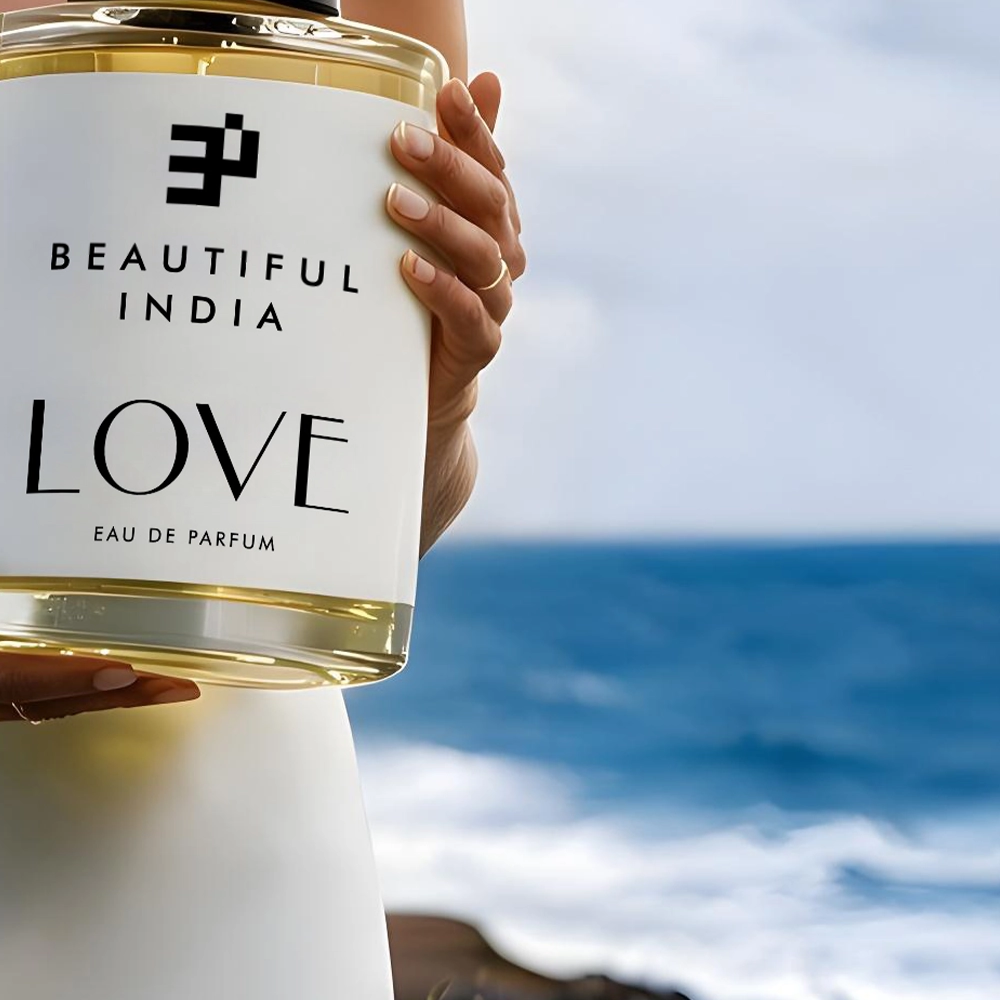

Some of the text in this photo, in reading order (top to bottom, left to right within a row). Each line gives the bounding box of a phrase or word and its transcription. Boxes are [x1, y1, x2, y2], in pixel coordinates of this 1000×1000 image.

[50, 242, 360, 294] BEAUTIFUL
[119, 292, 283, 332] INDIA
[25, 399, 350, 514] LOVE
[93, 526, 276, 552] EAU DE PARFUM
